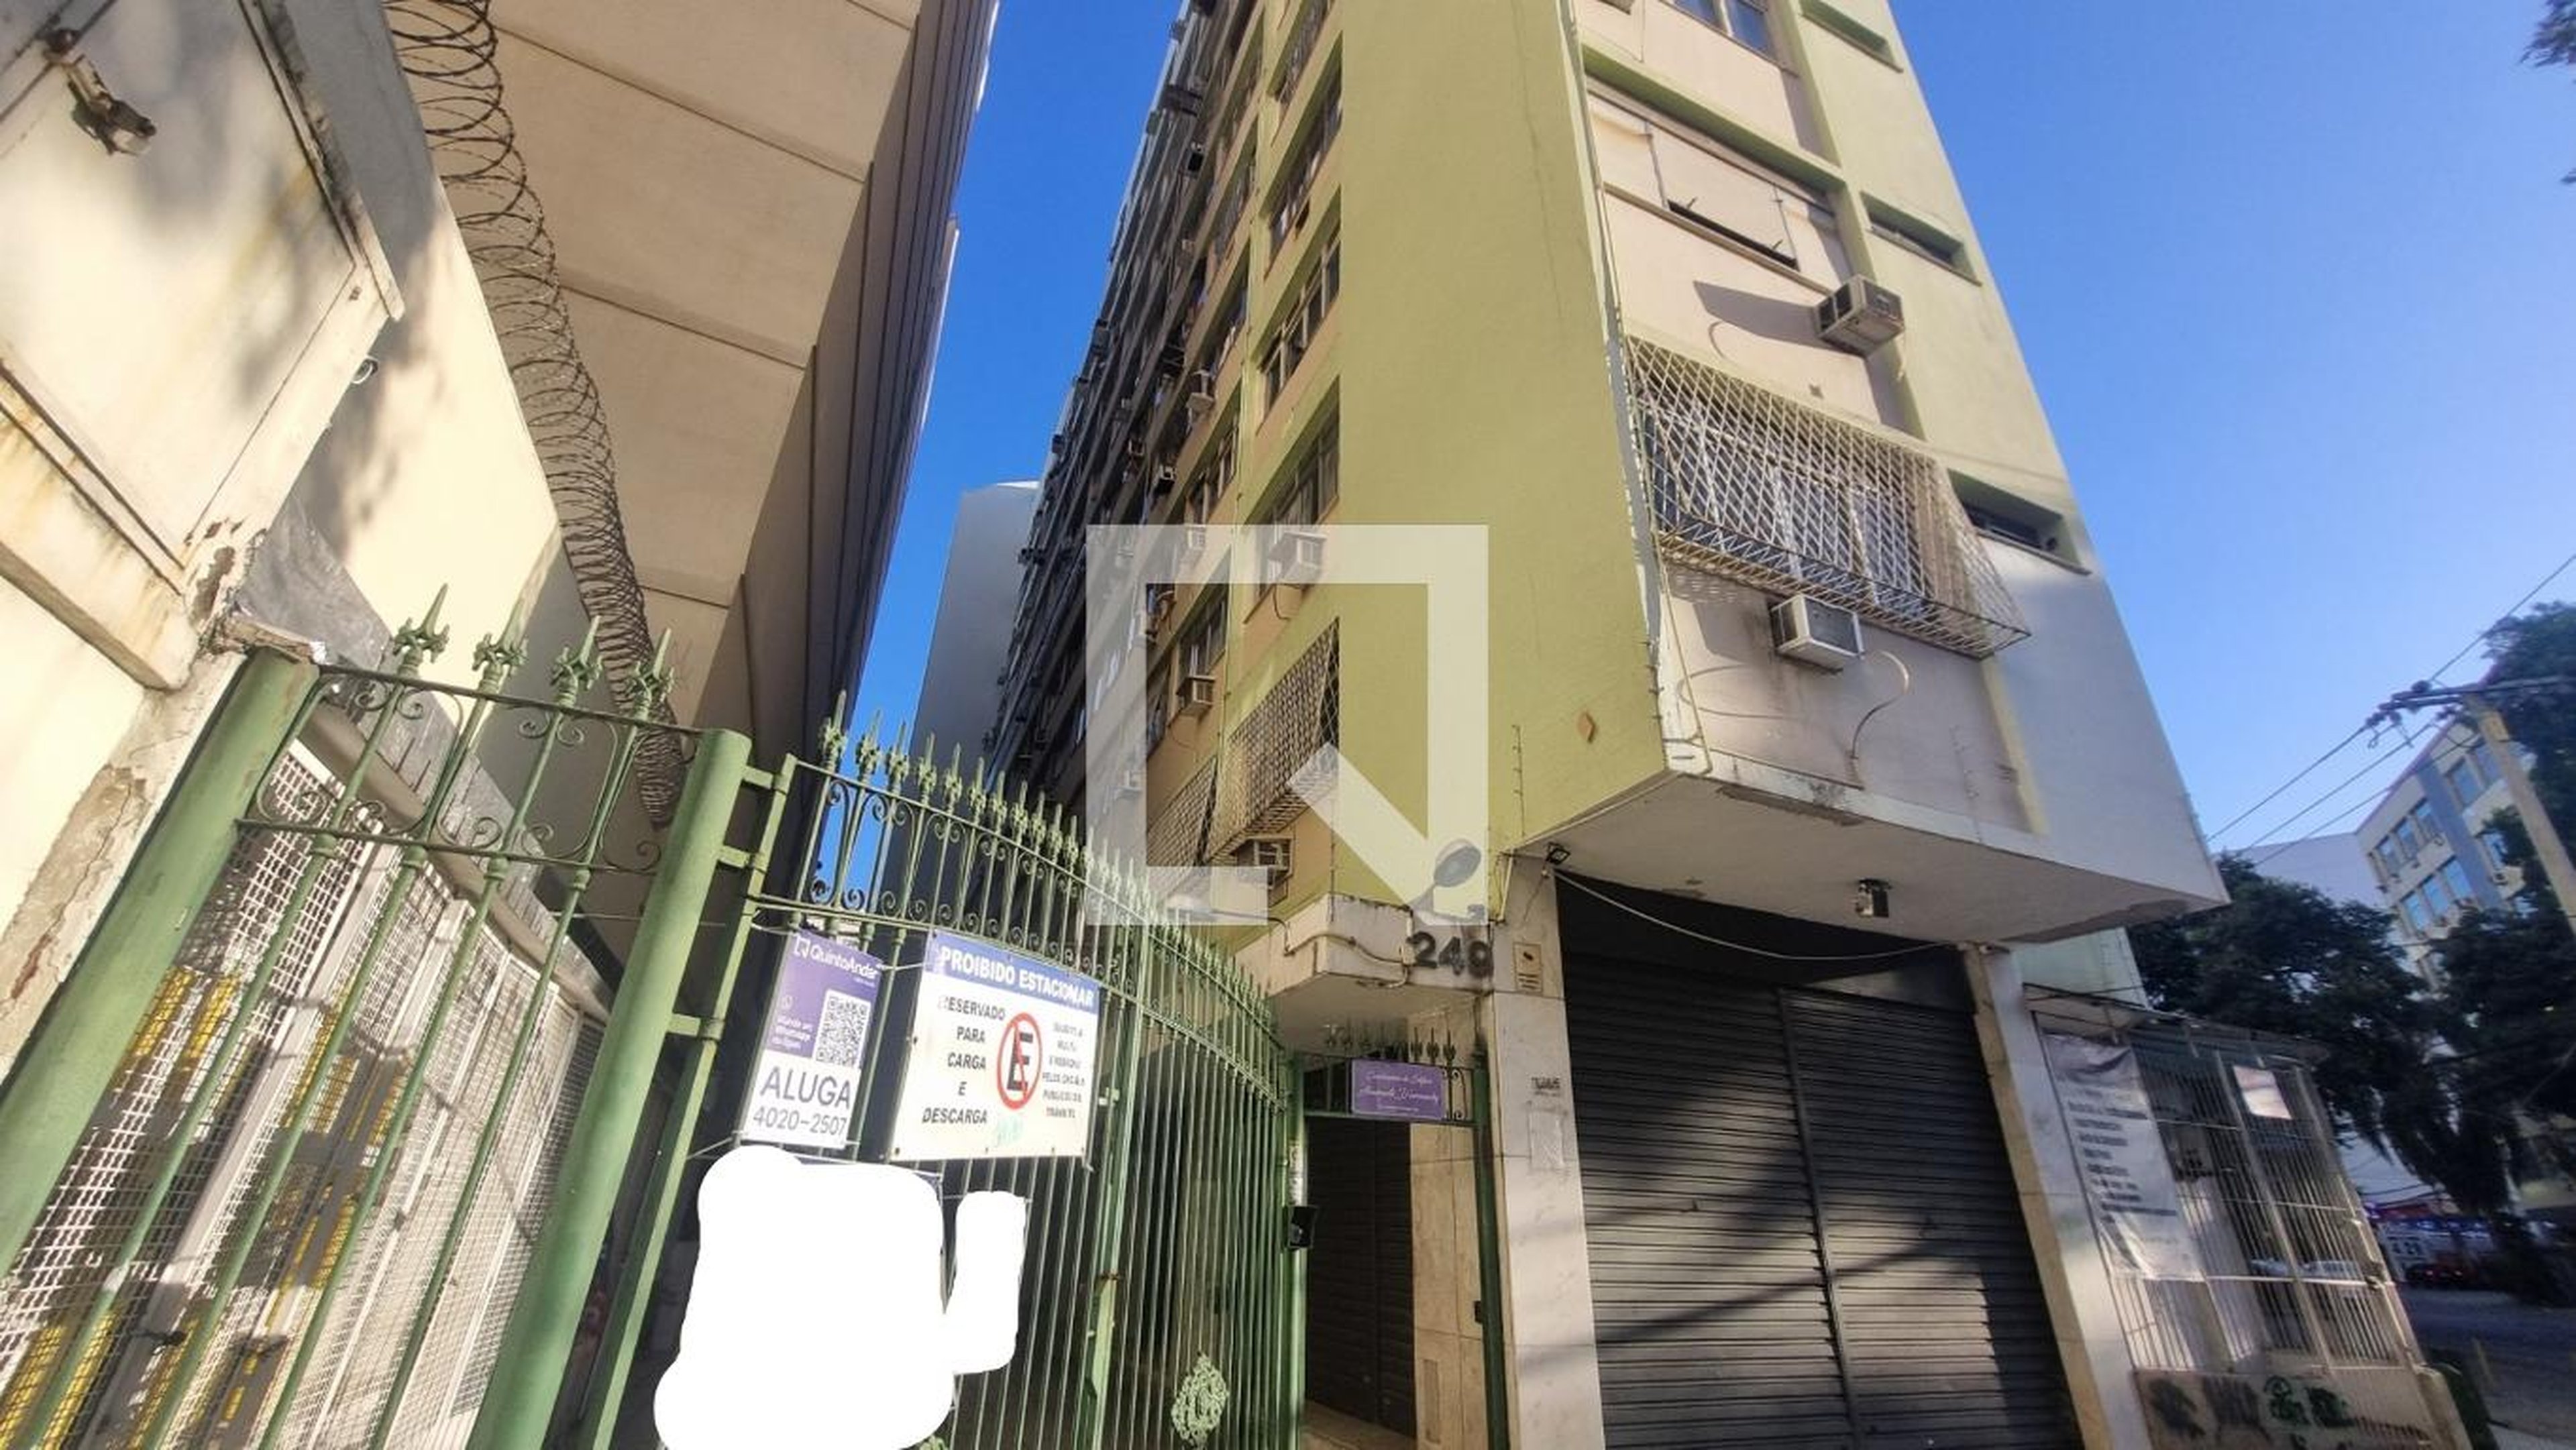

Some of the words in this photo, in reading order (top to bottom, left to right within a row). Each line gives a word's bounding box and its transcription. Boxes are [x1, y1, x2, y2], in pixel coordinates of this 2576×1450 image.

[939, 946, 1016, 985] PROIBIDO
[957, 1026, 985, 1044] PARA
[947, 1052, 987, 1070] CARGA
[759, 1066, 851, 1110] ALUGA
[958, 1080, 967, 1097] E
[753, 1106, 847, 1135] 4020-2507
[922, 1107, 987, 1125] DESCARGA
